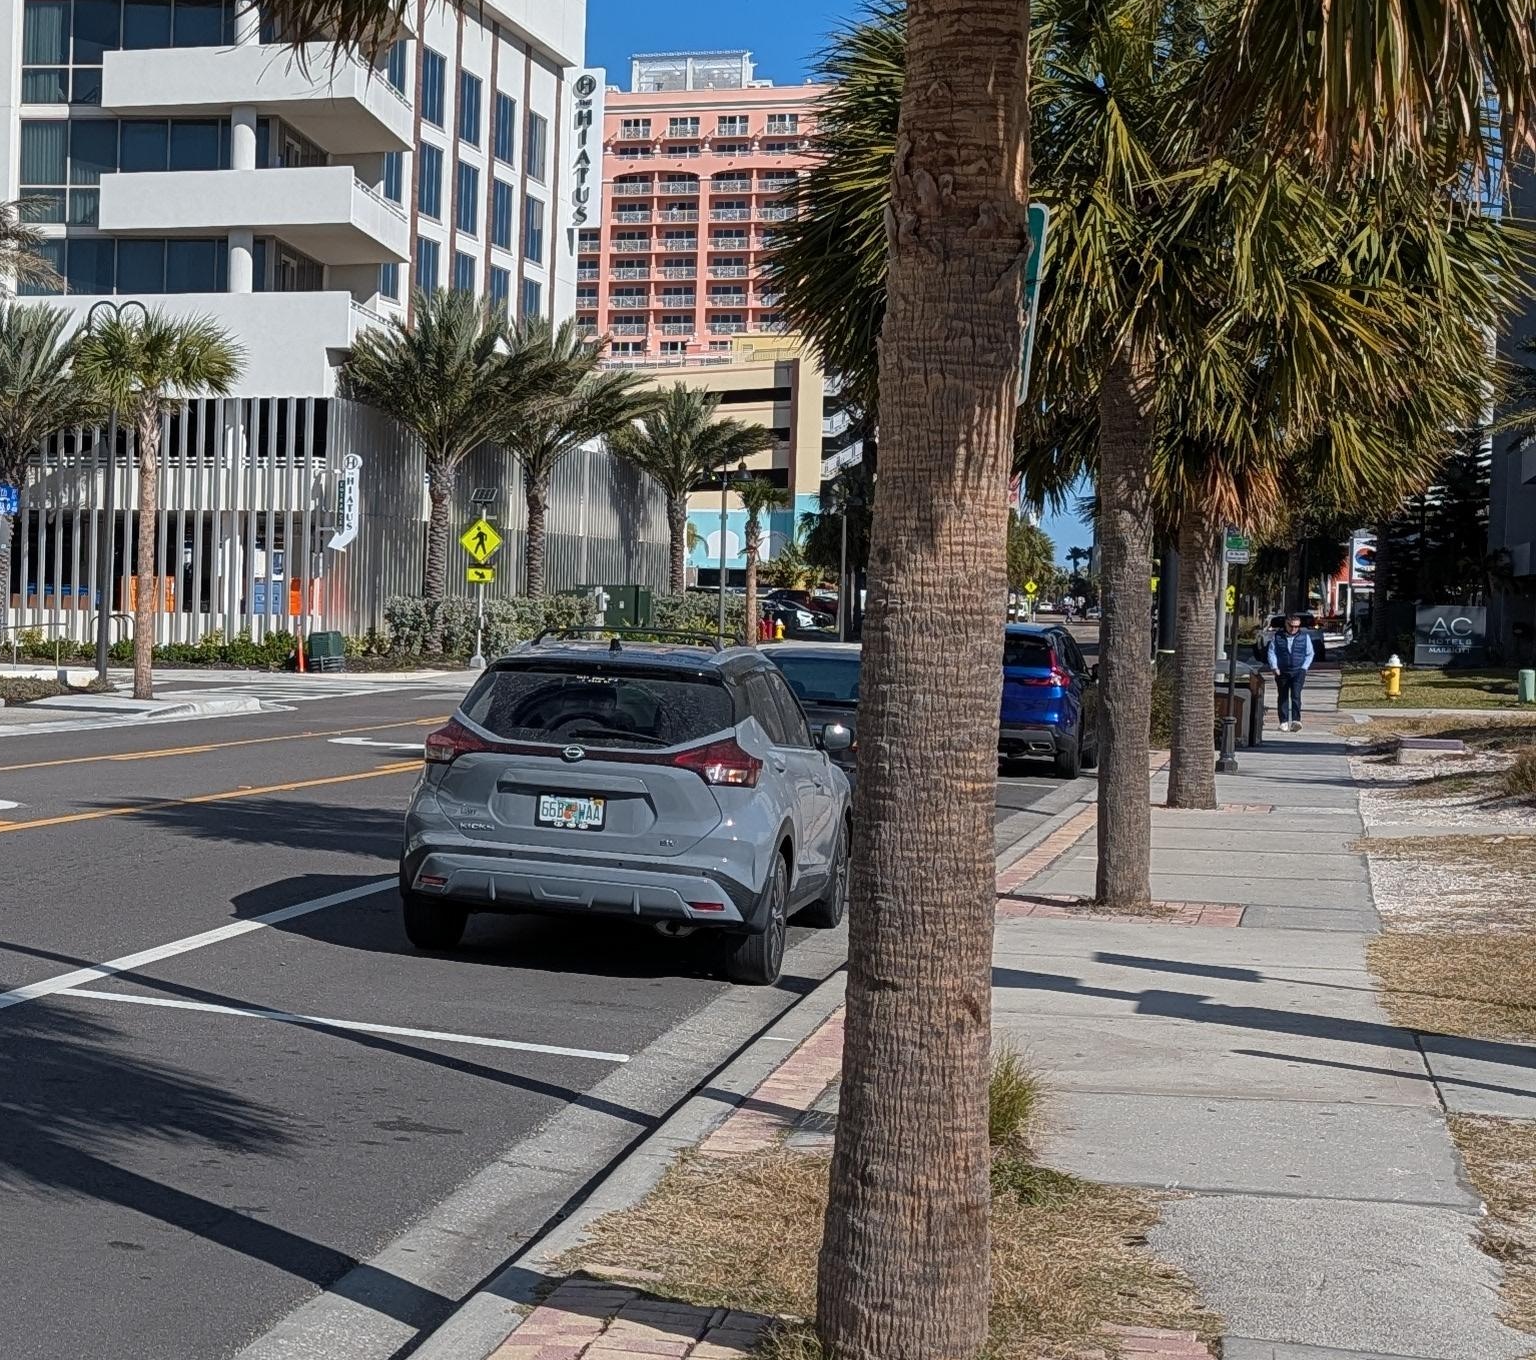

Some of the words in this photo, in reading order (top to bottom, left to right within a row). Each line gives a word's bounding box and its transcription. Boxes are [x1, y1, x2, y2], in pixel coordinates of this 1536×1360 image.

[573, 110, 592, 226] HIATUS
[346, 477, 354, 530] HIATUS
[1429, 617, 1472, 636] AC
[459, 822, 495, 830] KICKS
